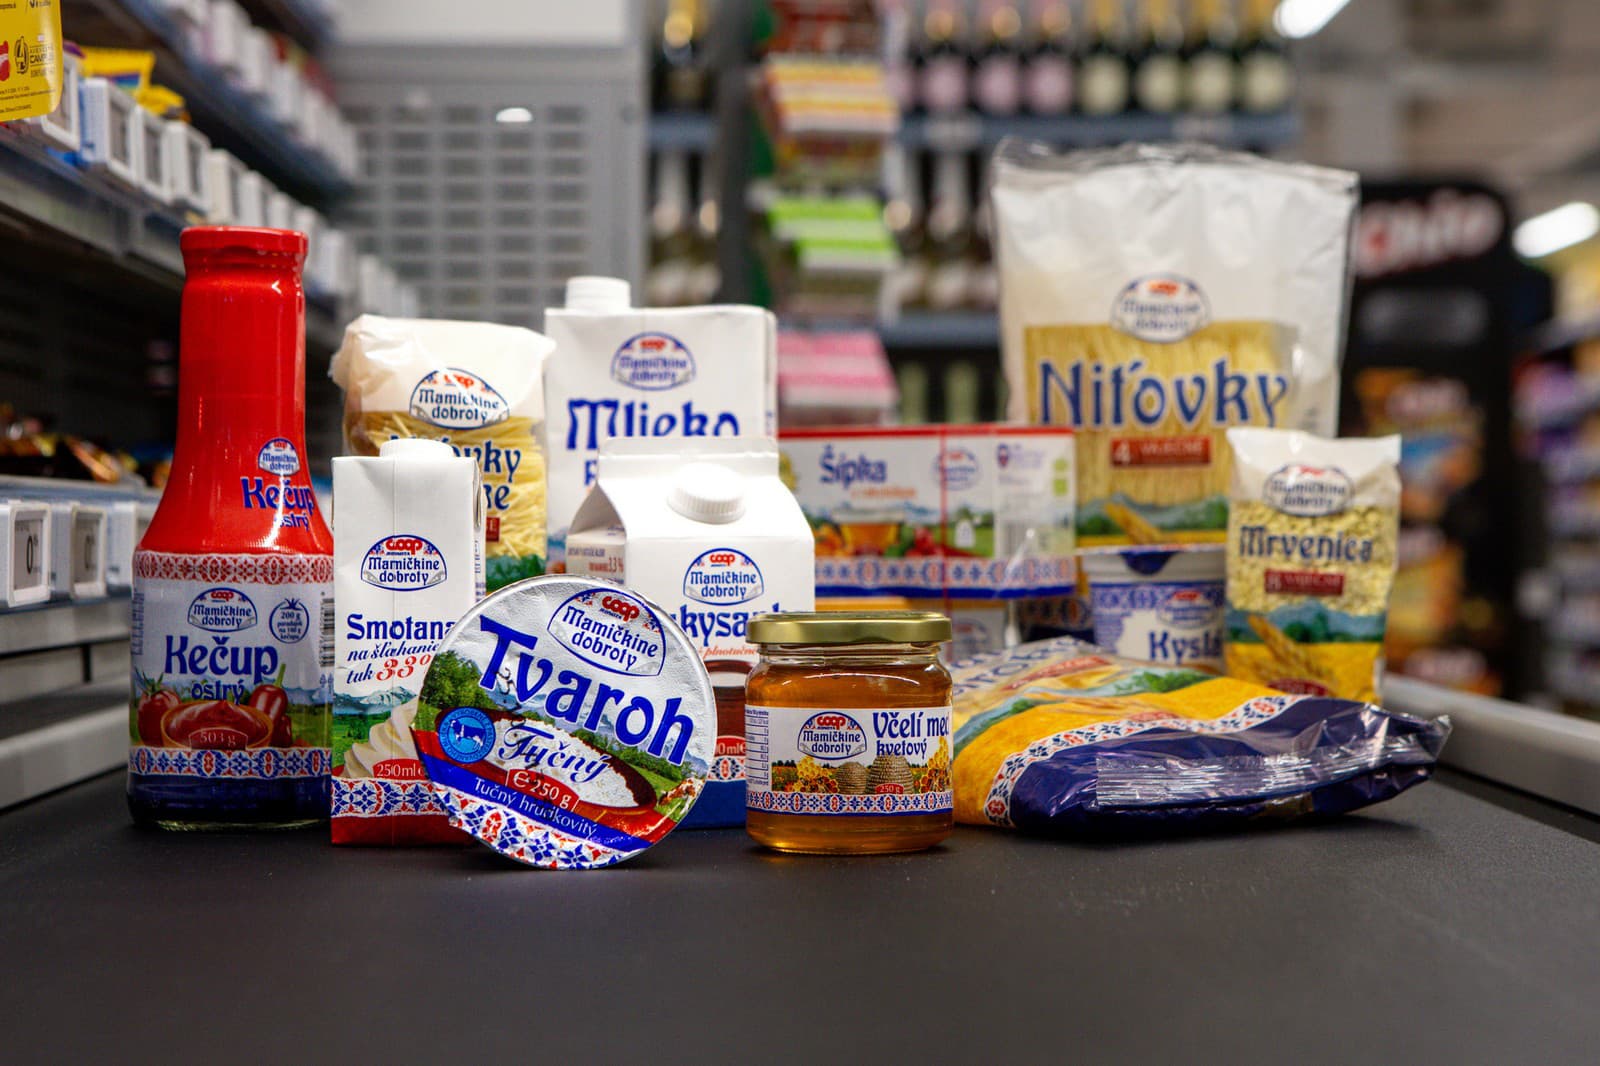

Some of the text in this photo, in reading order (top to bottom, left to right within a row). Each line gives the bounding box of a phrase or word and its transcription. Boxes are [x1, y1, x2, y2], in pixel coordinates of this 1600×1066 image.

[1040, 357, 1288, 427] Niťovky
[431, 406, 488, 424] dobroty
[240, 476, 315, 516] Kečup
[1239, 525, 1373, 563] Mrvenica
[368, 557, 440, 570] Mamičkine
[379, 570, 429, 585] dobroty
[690, 571, 757, 585] Mamičkine
[701, 584, 747, 599] dobroty
[193, 604, 251, 616] Mamičkine
[202, 615, 243, 628] dobroty
[562, 606, 659, 658] Mamičkine
[165, 635, 278, 685] Kečup
[347, 649, 367, 662] na
[571, 631, 637, 671] dobroty
[347, 663, 373, 685] tuk
[191, 678, 244, 705] ostrý
[478, 614, 694, 766] Tvaroh
[872, 711, 924, 739] Včelí
[803, 729, 861, 743] Mamičkine
[498, 722, 612, 784] Tučný
[811, 742, 851, 755] dobroty
[876, 738, 928, 759] kvetový
[376, 763, 416, 778] 250ml
[474, 776, 517, 809] Tučný
[530, 777, 560, 801] 250
[559, 793, 572, 809] g
[879, 785, 901, 795] 250 g
